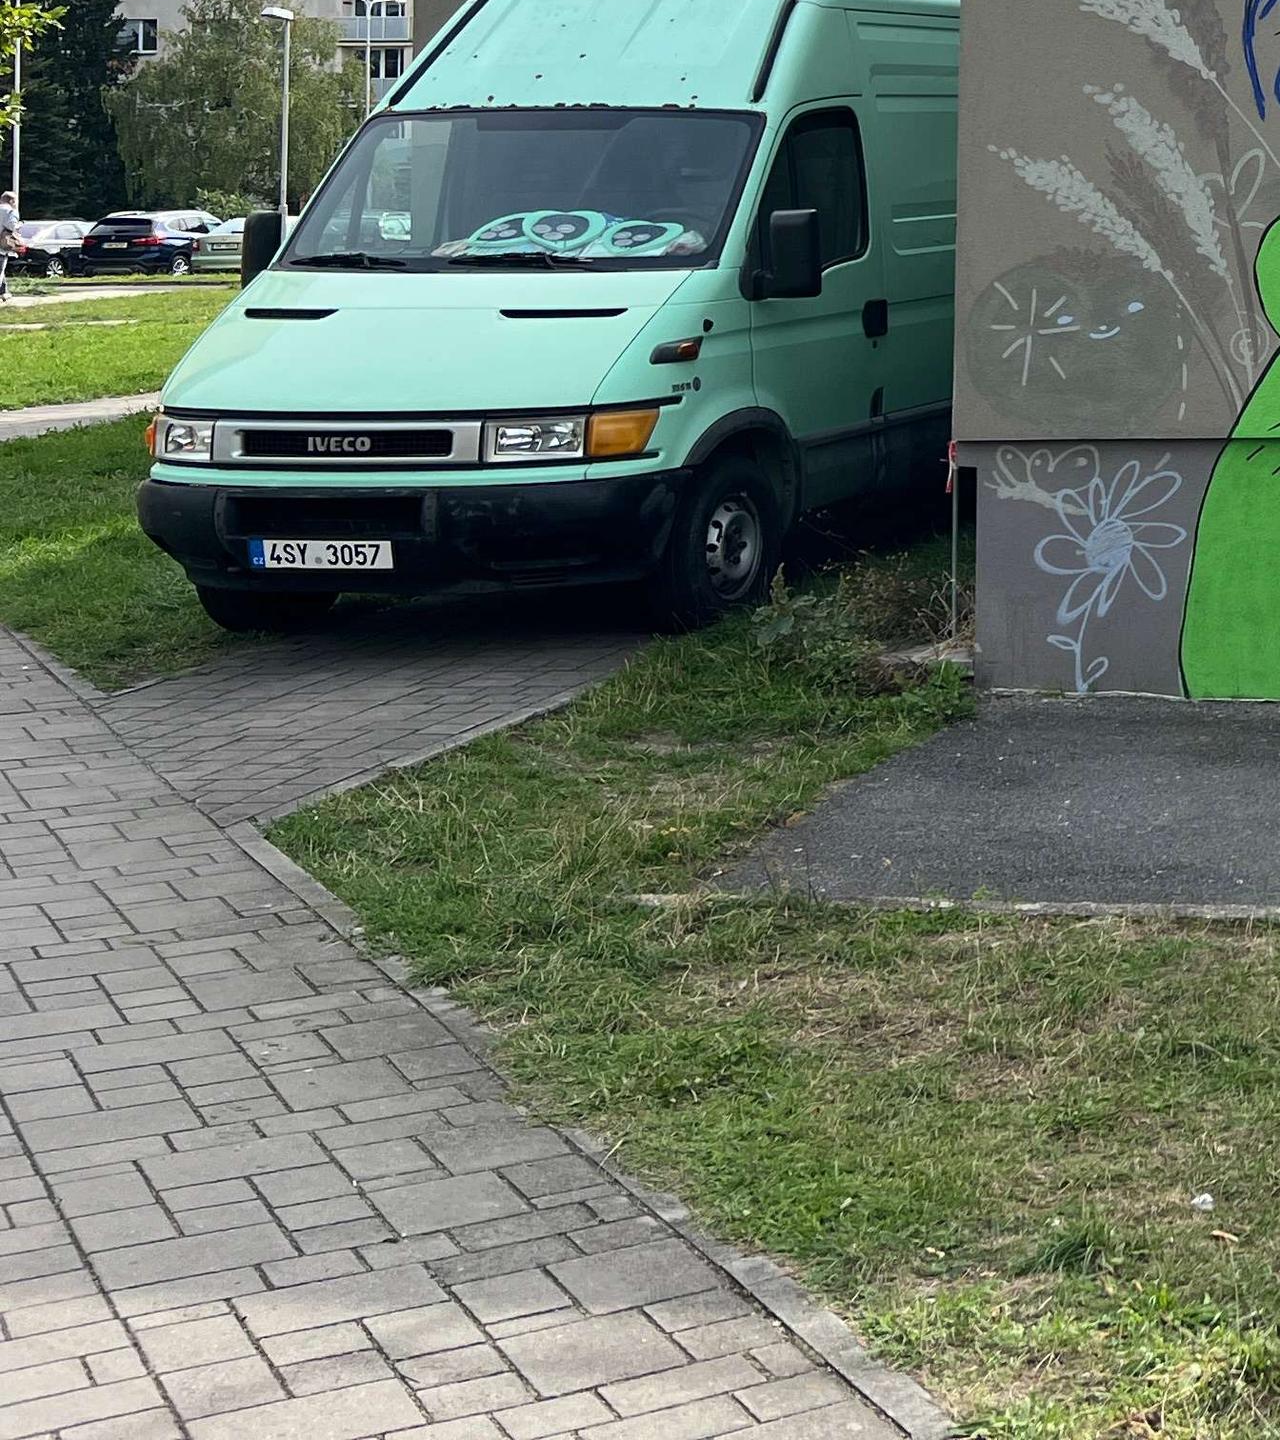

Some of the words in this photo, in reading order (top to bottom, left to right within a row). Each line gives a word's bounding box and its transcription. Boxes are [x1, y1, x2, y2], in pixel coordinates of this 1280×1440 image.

[307, 436, 371, 452] IVECO
[252, 556, 265, 565] CZ
[269, 543, 308, 565] 4SY
[326, 544, 381, 566] 3057
